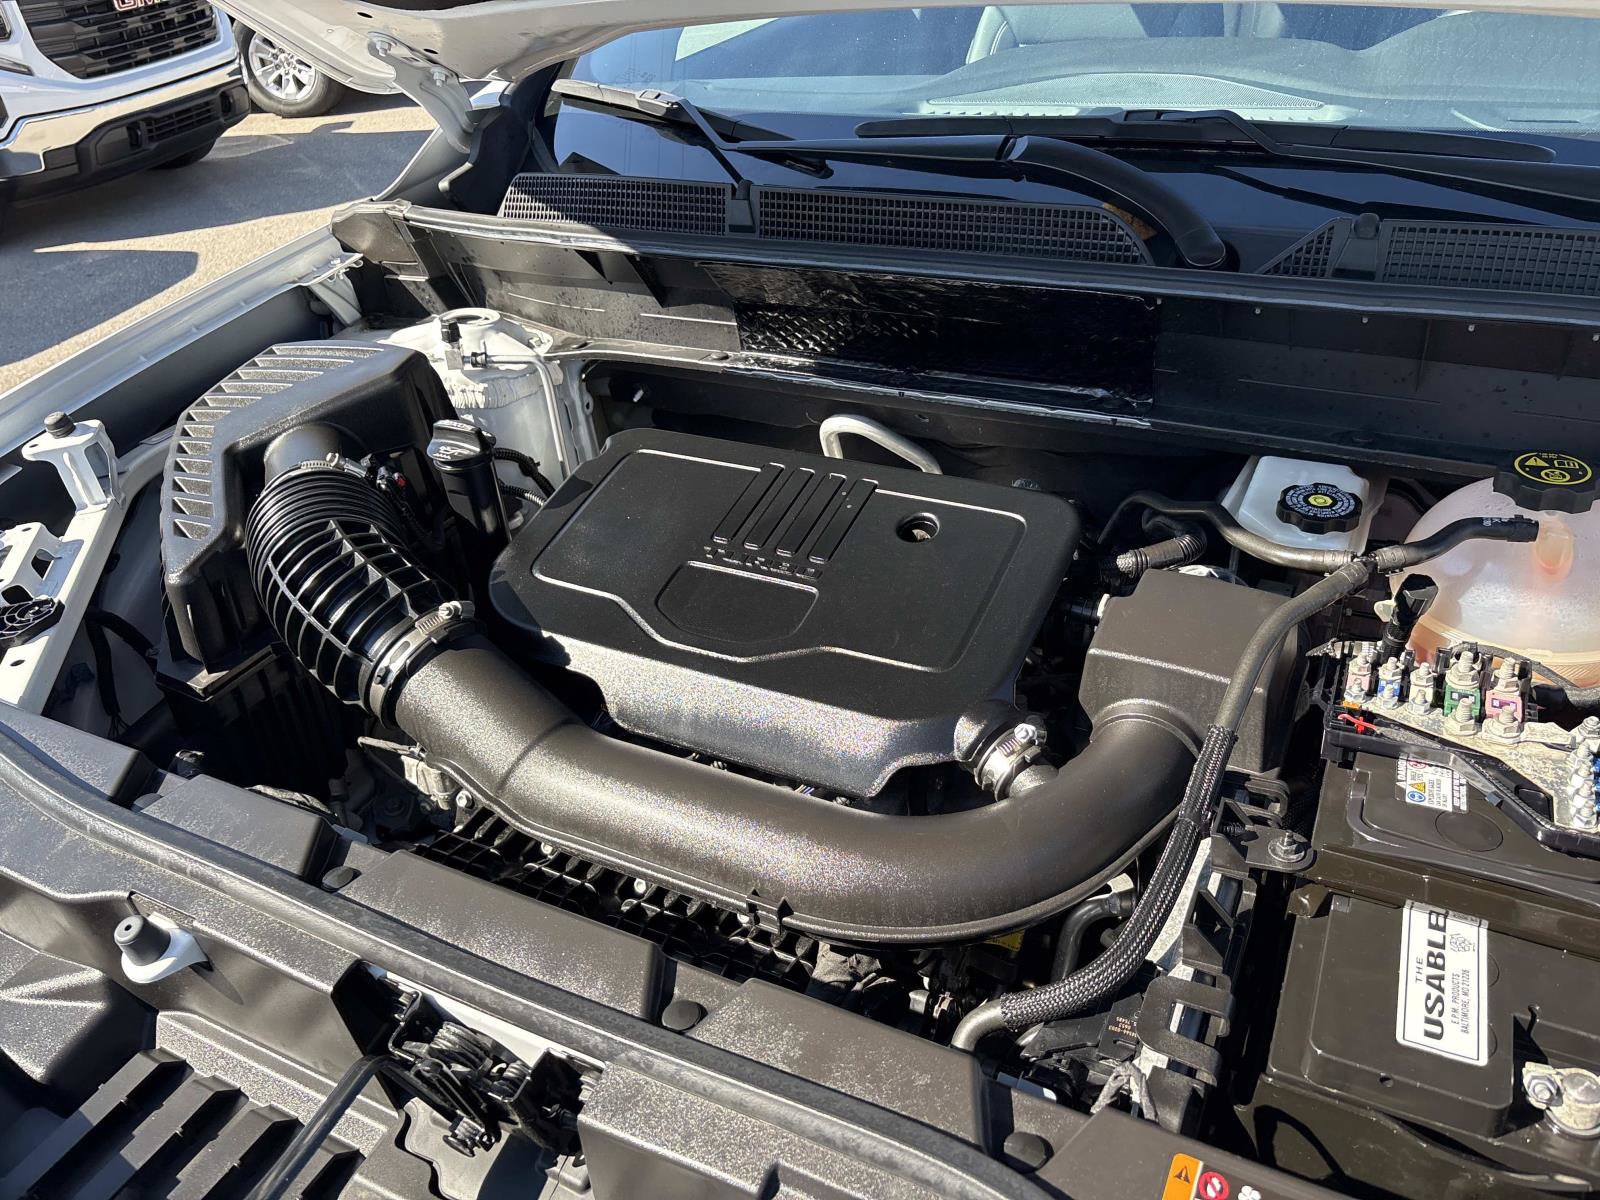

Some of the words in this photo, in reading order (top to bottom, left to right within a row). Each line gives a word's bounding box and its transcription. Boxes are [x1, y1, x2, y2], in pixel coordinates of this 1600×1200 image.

[703, 545, 824, 581] TURBO
[1415, 957, 1424, 983] THE
[1424, 909, 1448, 1041] USABLE
[1451, 972, 1460, 1005] PRODUCTS
[1462, 987, 1470, 997] MD
[1460, 998, 1470, 1034] BALTIMORE,
